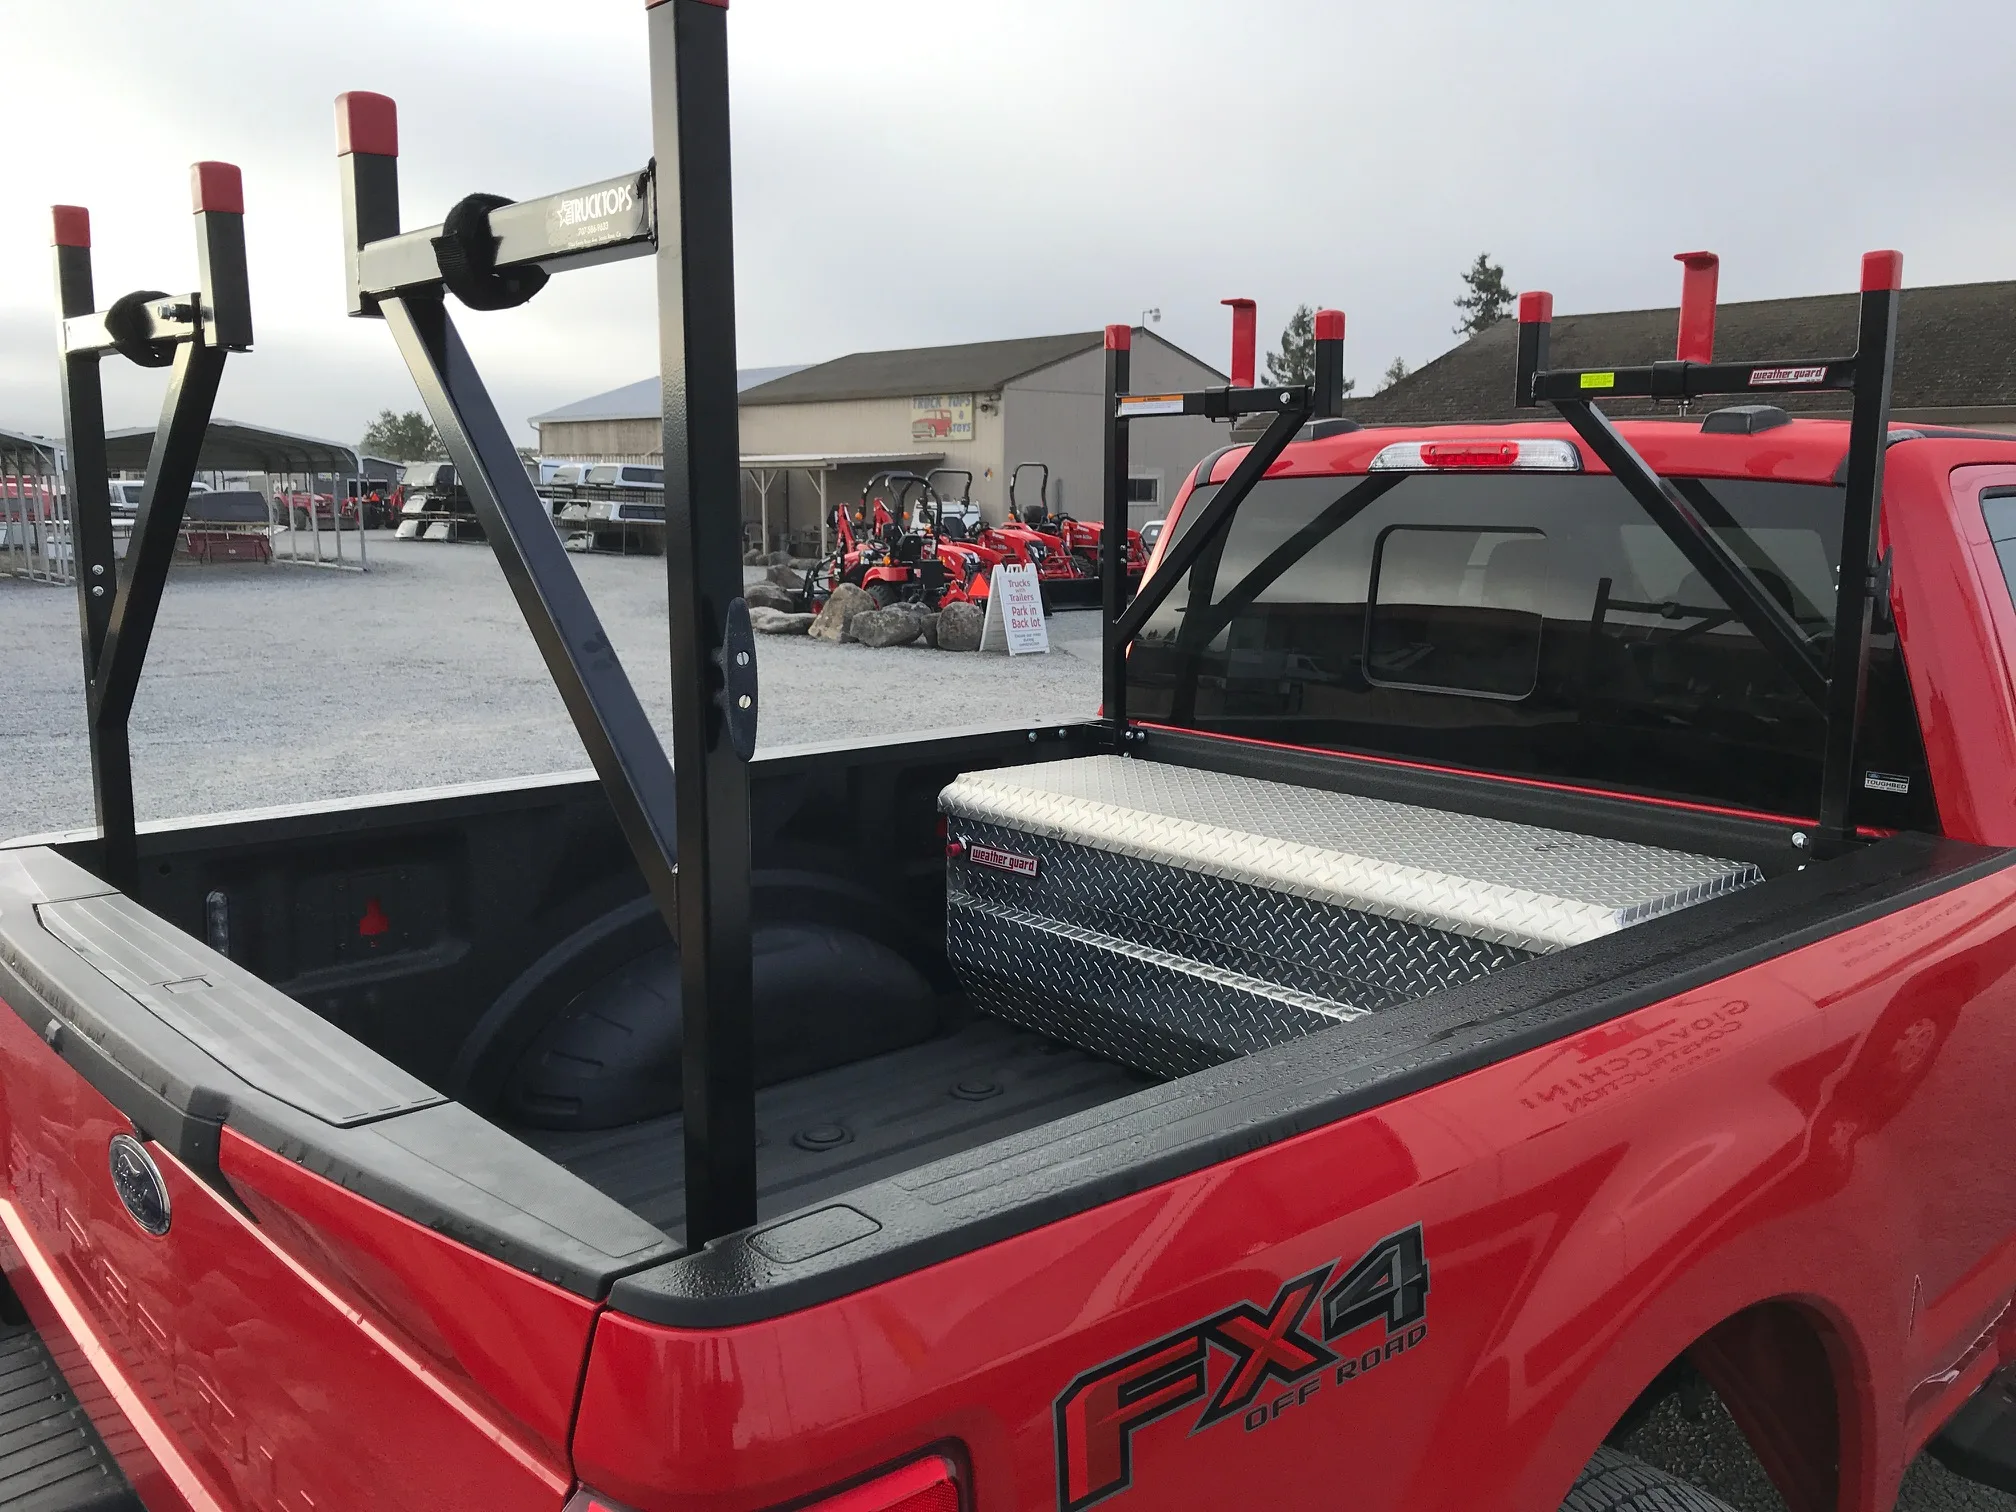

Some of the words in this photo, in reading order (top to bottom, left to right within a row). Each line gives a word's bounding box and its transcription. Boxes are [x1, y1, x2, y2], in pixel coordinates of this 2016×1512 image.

[1753, 369, 1793, 380] weather
[1794, 367, 1823, 380] guard
[952, 423, 971, 432] TOYS
[1008, 579, 1031, 588] Trucks
[1009, 594, 1034, 602] Trailers
[1012, 605, 1028, 616] Park
[1030, 605, 1037, 615] in
[1012, 618, 1029, 629] Back
[1030, 617, 1041, 628] lot
[1867, 779, 1907, 790] TOUGHBED
[972, 848, 1008, 865] weather
[1008, 856, 1035, 872] guard
[1052, 1220, 1431, 1512] FX4
[1243, 1378, 1321, 1434] OFF
[1335, 1323, 1429, 1387] ROAD
